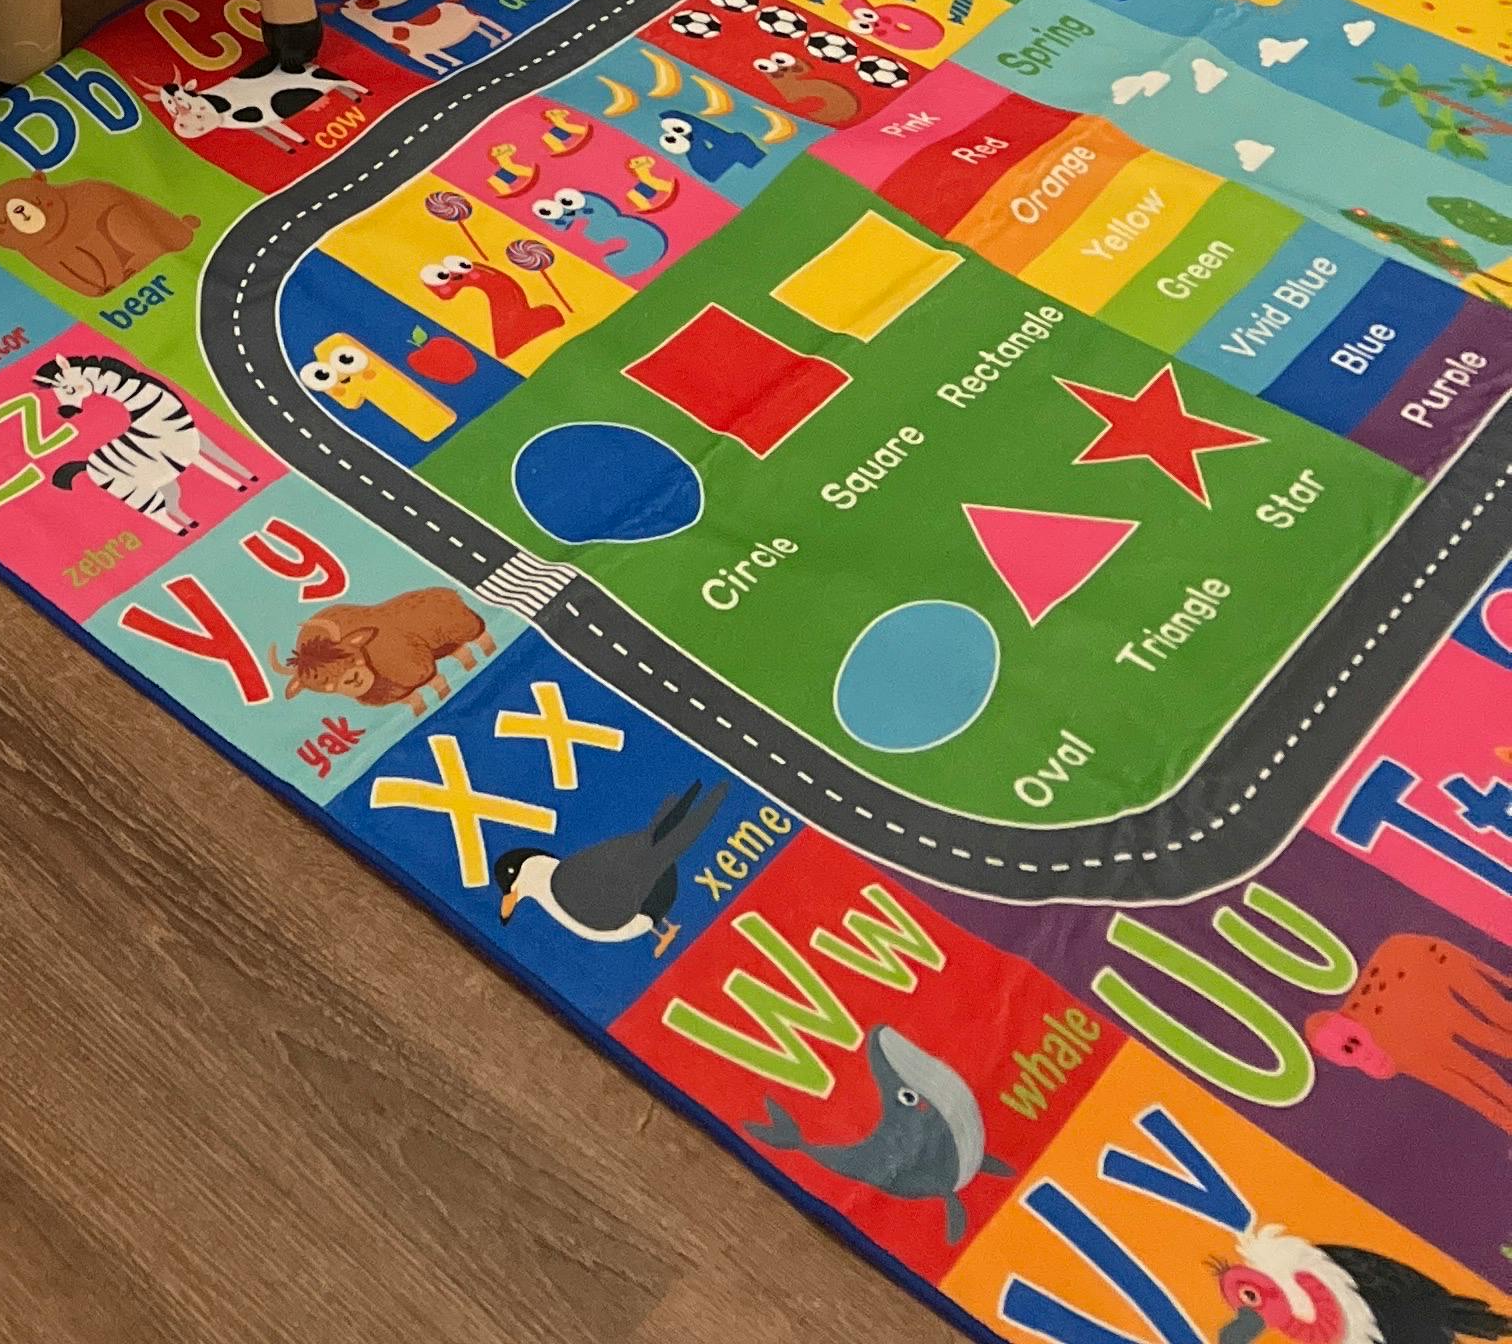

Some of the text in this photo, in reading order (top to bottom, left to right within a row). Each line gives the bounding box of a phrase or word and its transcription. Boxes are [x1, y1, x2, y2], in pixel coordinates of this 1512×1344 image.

[996, 12, 1097, 78] Spring
[315, 103, 367, 153] cow
[880, 108, 938, 141] Pink
[952, 134, 1011, 169] Red
[1010, 142, 1098, 226] Orange
[1079, 187, 1169, 267] Yellow
[98, 272, 176, 332] bear
[1156, 238, 1236, 303] Green
[1219, 253, 1339, 362] Vivid Blue
[935, 302, 1065, 410] Rectangle
[1329, 321, 1398, 377] Blue
[1399, 346, 1490, 431] Purple
[819, 424, 927, 513] Square
[1255, 466, 1326, 532] Star
[63, 527, 143, 591] zebra
[699, 531, 800, 614] Circle
[1114, 574, 1232, 676] Triangle
[296, 714, 367, 779] yak
[1013, 728, 1098, 811] Oval
[693, 802, 793, 904] xeme
[662, 884, 946, 1100] Ww
[1090, 882, 1358, 1108] Uu
[999, 1005, 1103, 1122] whale
